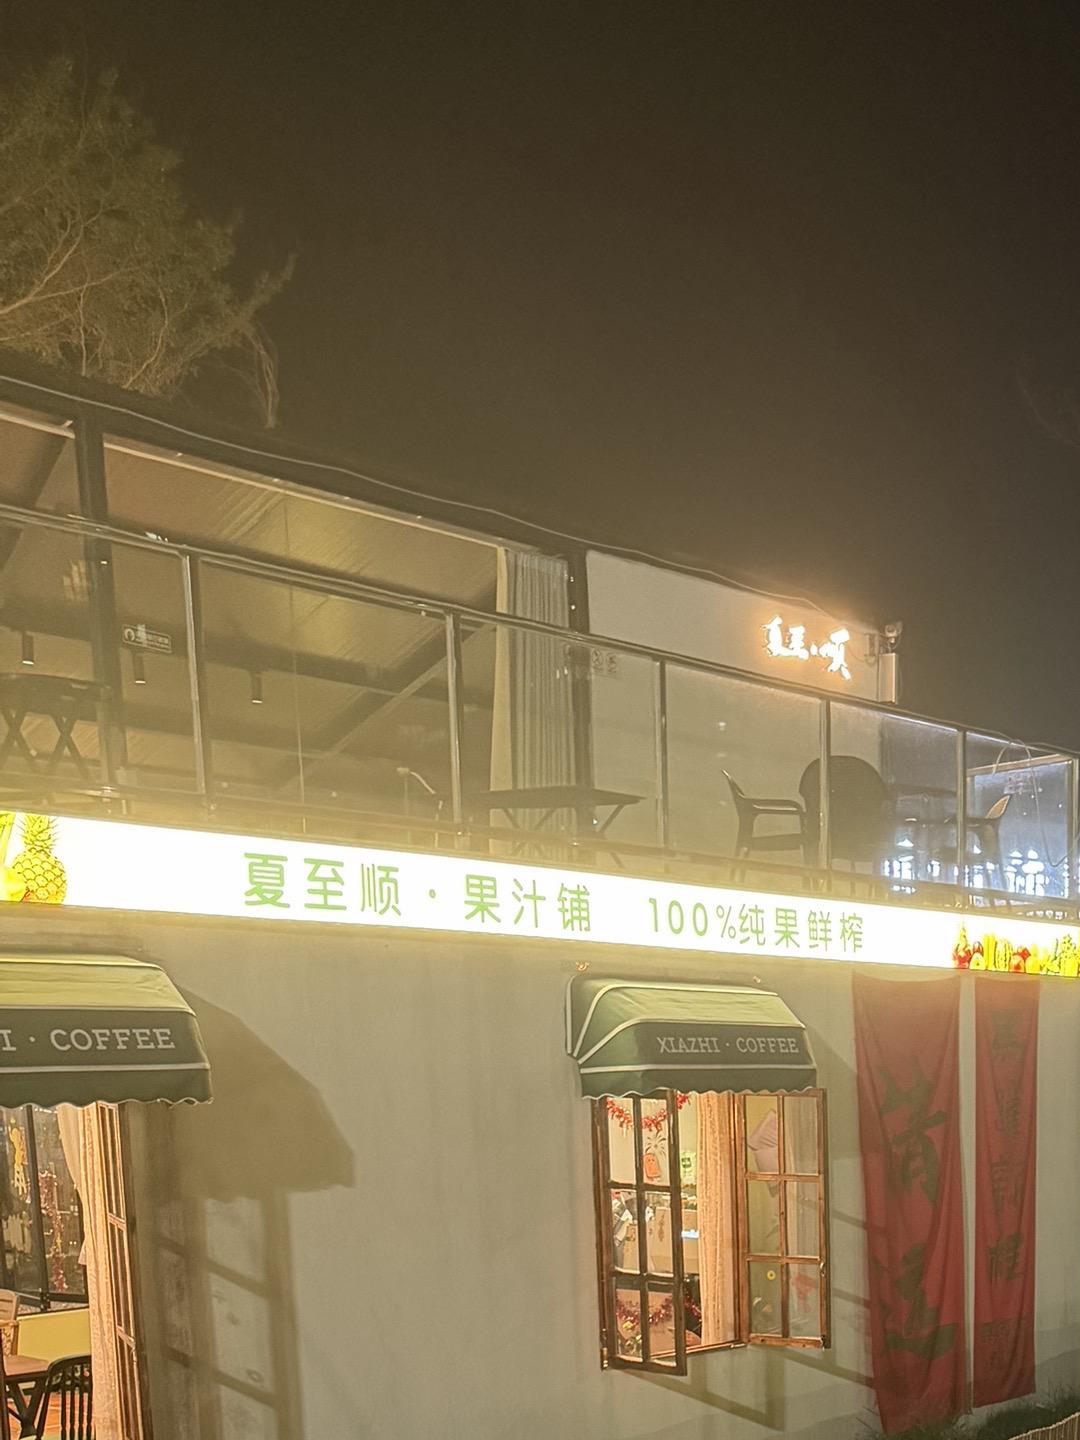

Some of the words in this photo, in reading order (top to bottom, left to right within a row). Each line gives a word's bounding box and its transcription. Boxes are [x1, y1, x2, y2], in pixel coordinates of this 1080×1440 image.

[50, 1028, 176, 1051] COFFEE
[656, 1036, 721, 1053] XIAZHI
[736, 1037, 799, 1053] COFFEE
